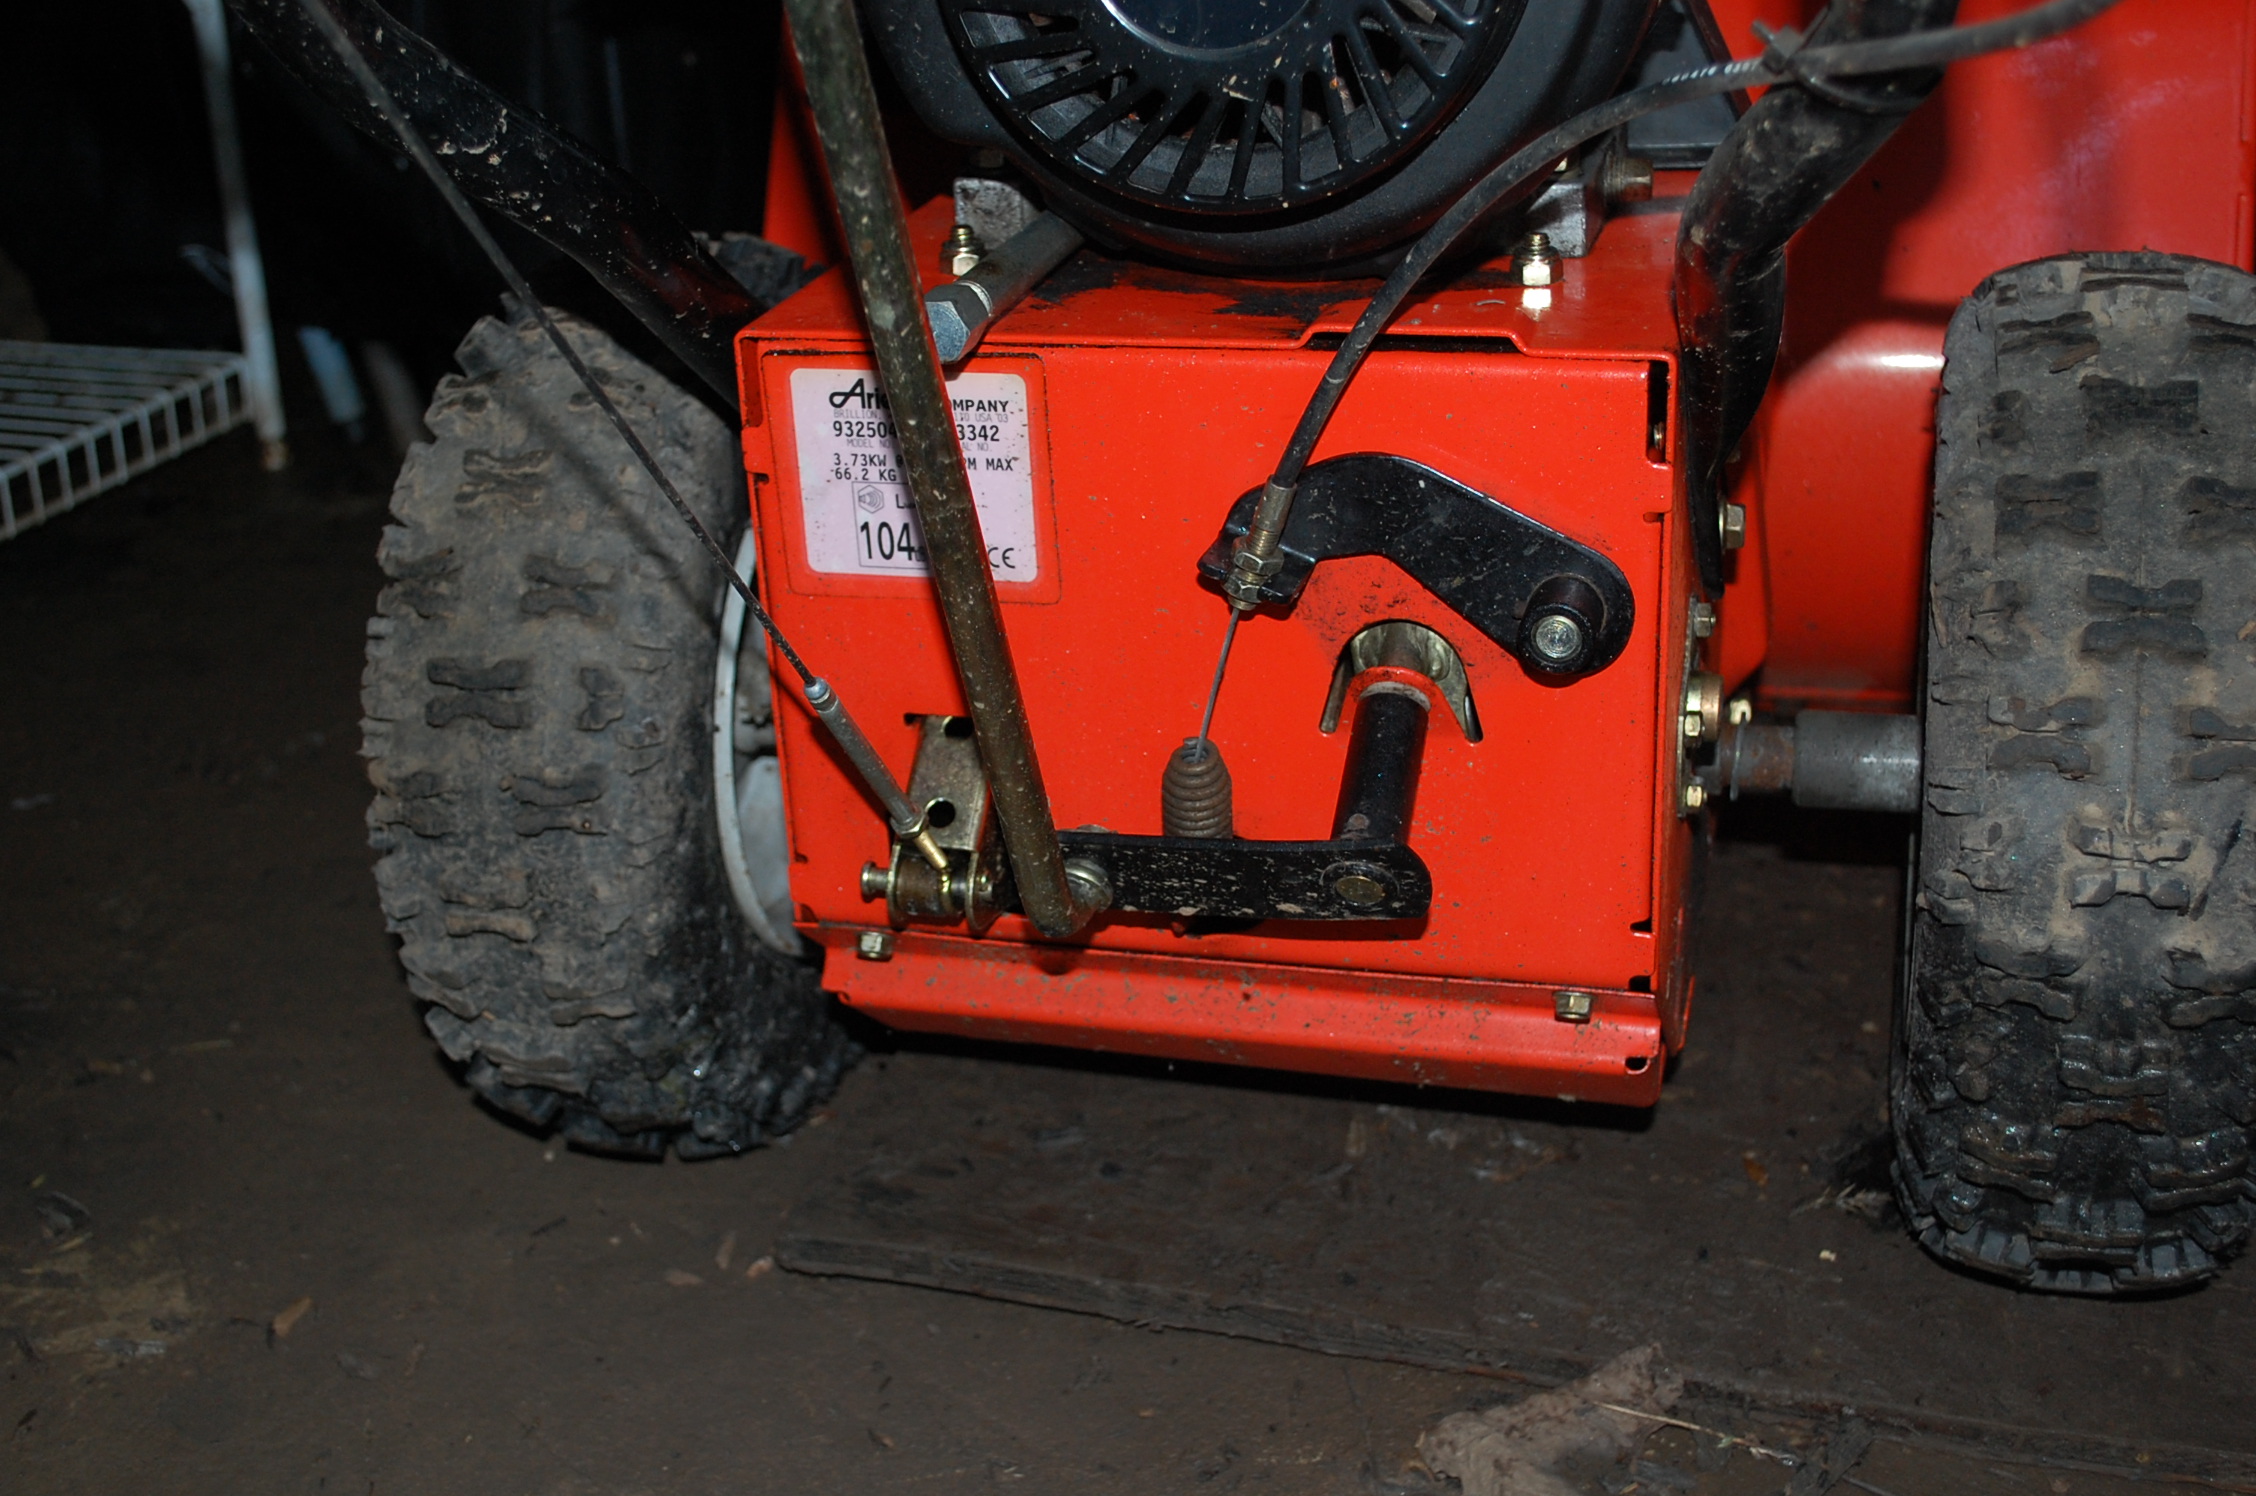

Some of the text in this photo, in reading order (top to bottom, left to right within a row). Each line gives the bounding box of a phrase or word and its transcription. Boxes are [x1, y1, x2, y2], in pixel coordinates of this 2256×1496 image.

[950, 399, 1009, 412] MPANY
[846, 439, 874, 449] MODEL
[833, 453, 887, 467] 3.73KW
[986, 458, 1013, 472] MAX
[879, 468, 897, 482] KG
